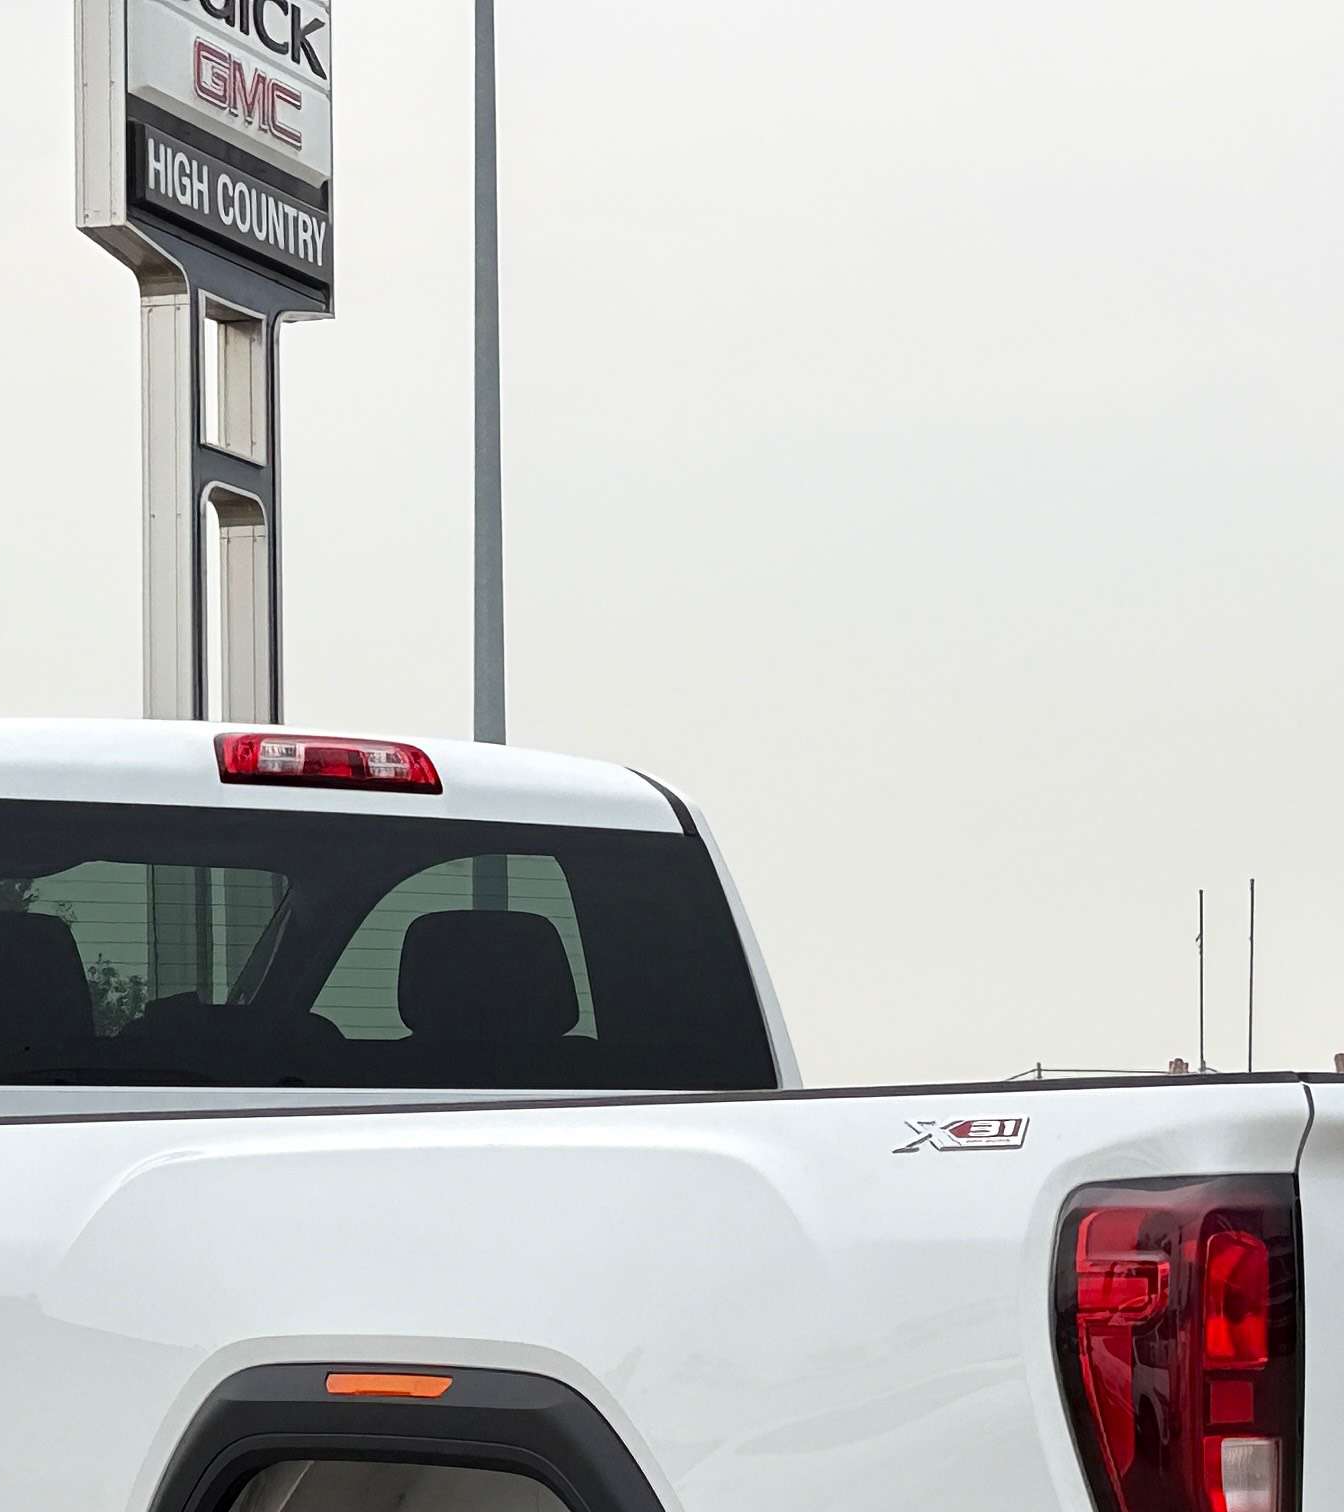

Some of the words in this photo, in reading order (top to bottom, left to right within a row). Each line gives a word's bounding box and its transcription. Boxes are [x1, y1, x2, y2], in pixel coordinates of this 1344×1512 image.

[193, 36, 302, 151] GMC
[148, 138, 210, 215] HIGH
[217, 173, 326, 266] COUNTRY
